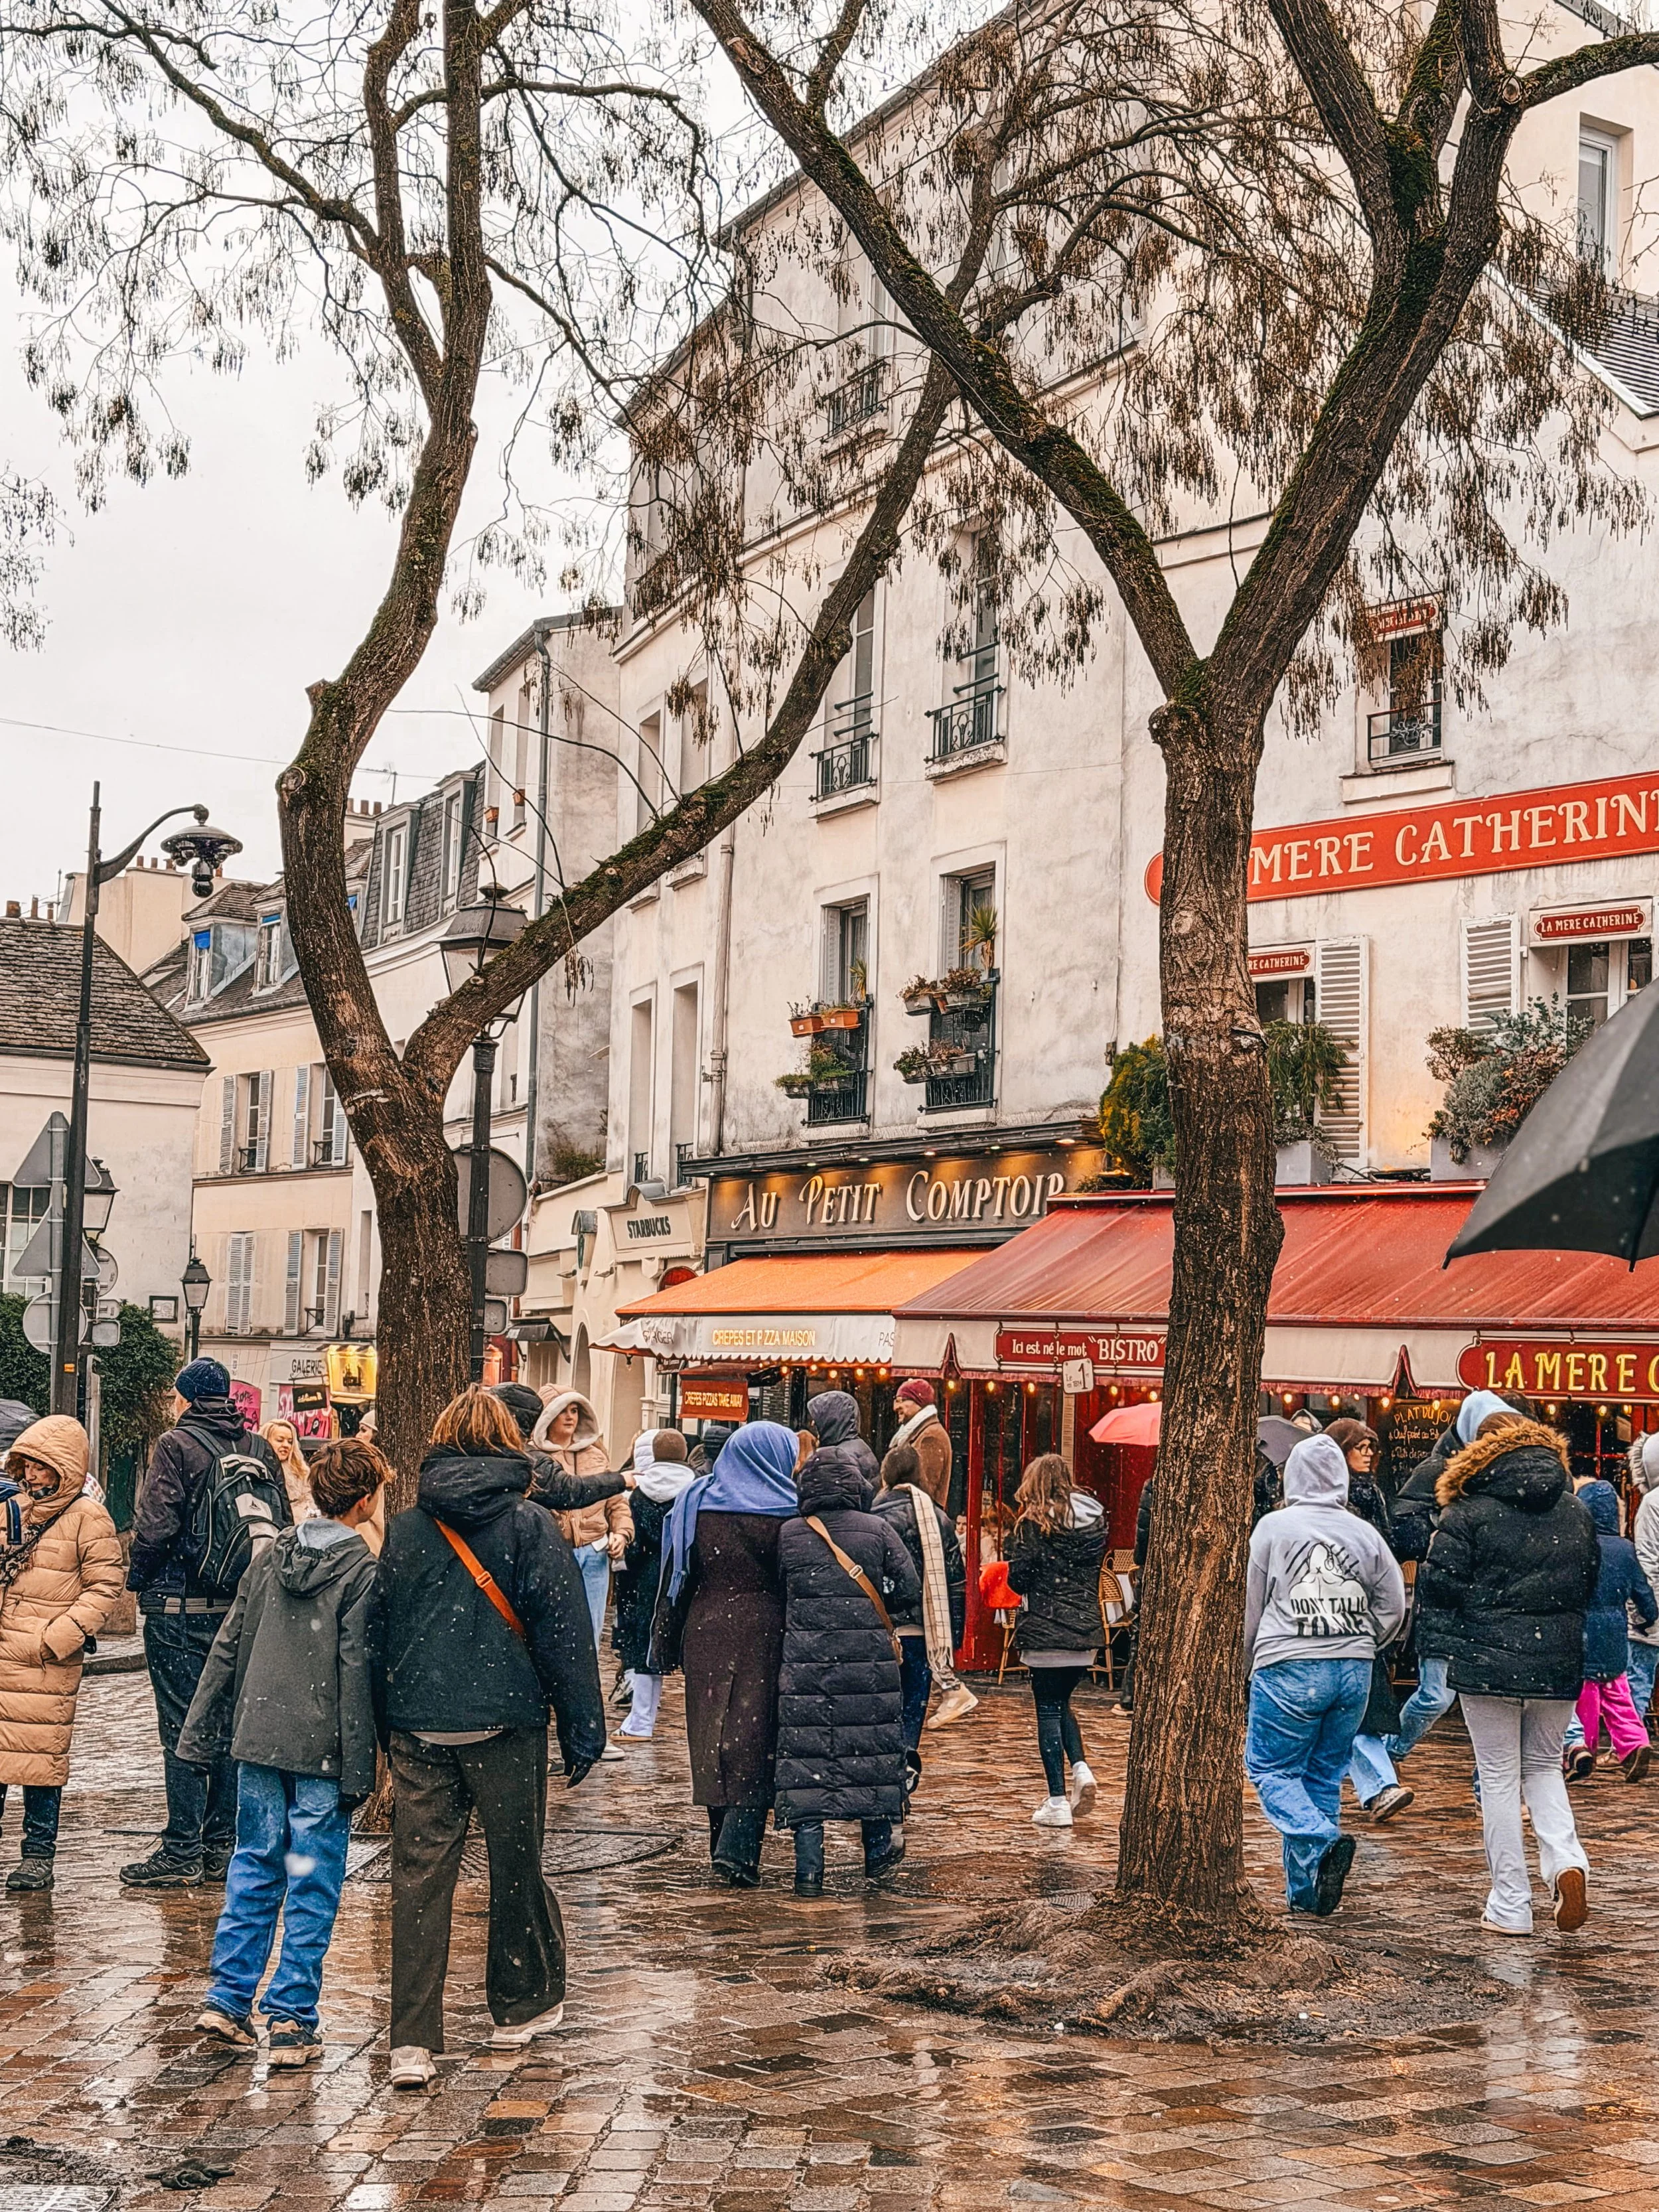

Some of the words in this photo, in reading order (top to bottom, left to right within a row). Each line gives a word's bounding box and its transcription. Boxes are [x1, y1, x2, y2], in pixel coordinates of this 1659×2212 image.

[1250, 831, 1374, 885] MERE
[1541, 921, 1552, 932] LA
[1555, 918, 1581, 931] MERE
[1583, 913, 1640, 928] CATHERINE
[1259, 955, 1305, 969] CATHERINE
[731, 1183, 778, 1230] AU
[799, 1175, 881, 1224] PETIT
[627, 1216, 671, 1239] STARBUCKS
[712, 1329, 744, 1346] CREPES
[745, 1329, 756, 1346] ET
[757, 1329, 780, 1346] PZZA
[782, 1329, 816, 1347] MAISON
[1012, 1339, 1023, 1354] Ici
[1026, 1343, 1041, 1355] est
[1043, 1341, 1054, 1355] né
[1056, 1341, 1066, 1355] le
[1067, 1342, 1087, 1357] mot
[1485, 1351, 1525, 1389] LA
[1534, 1353, 1638, 1392] MERE
[685, 1391, 702, 1406] CREPES
[703, 1392, 718, 1406] PIZZAS
[718, 1392, 730, 1407] TAKE
[731, 1394, 743, 1408] AWAY
[1394, 1406, 1421, 1425] PLAT
[1421, 1406, 1435, 1420] DU
[1432, 1409, 1456, 1426] JOU
